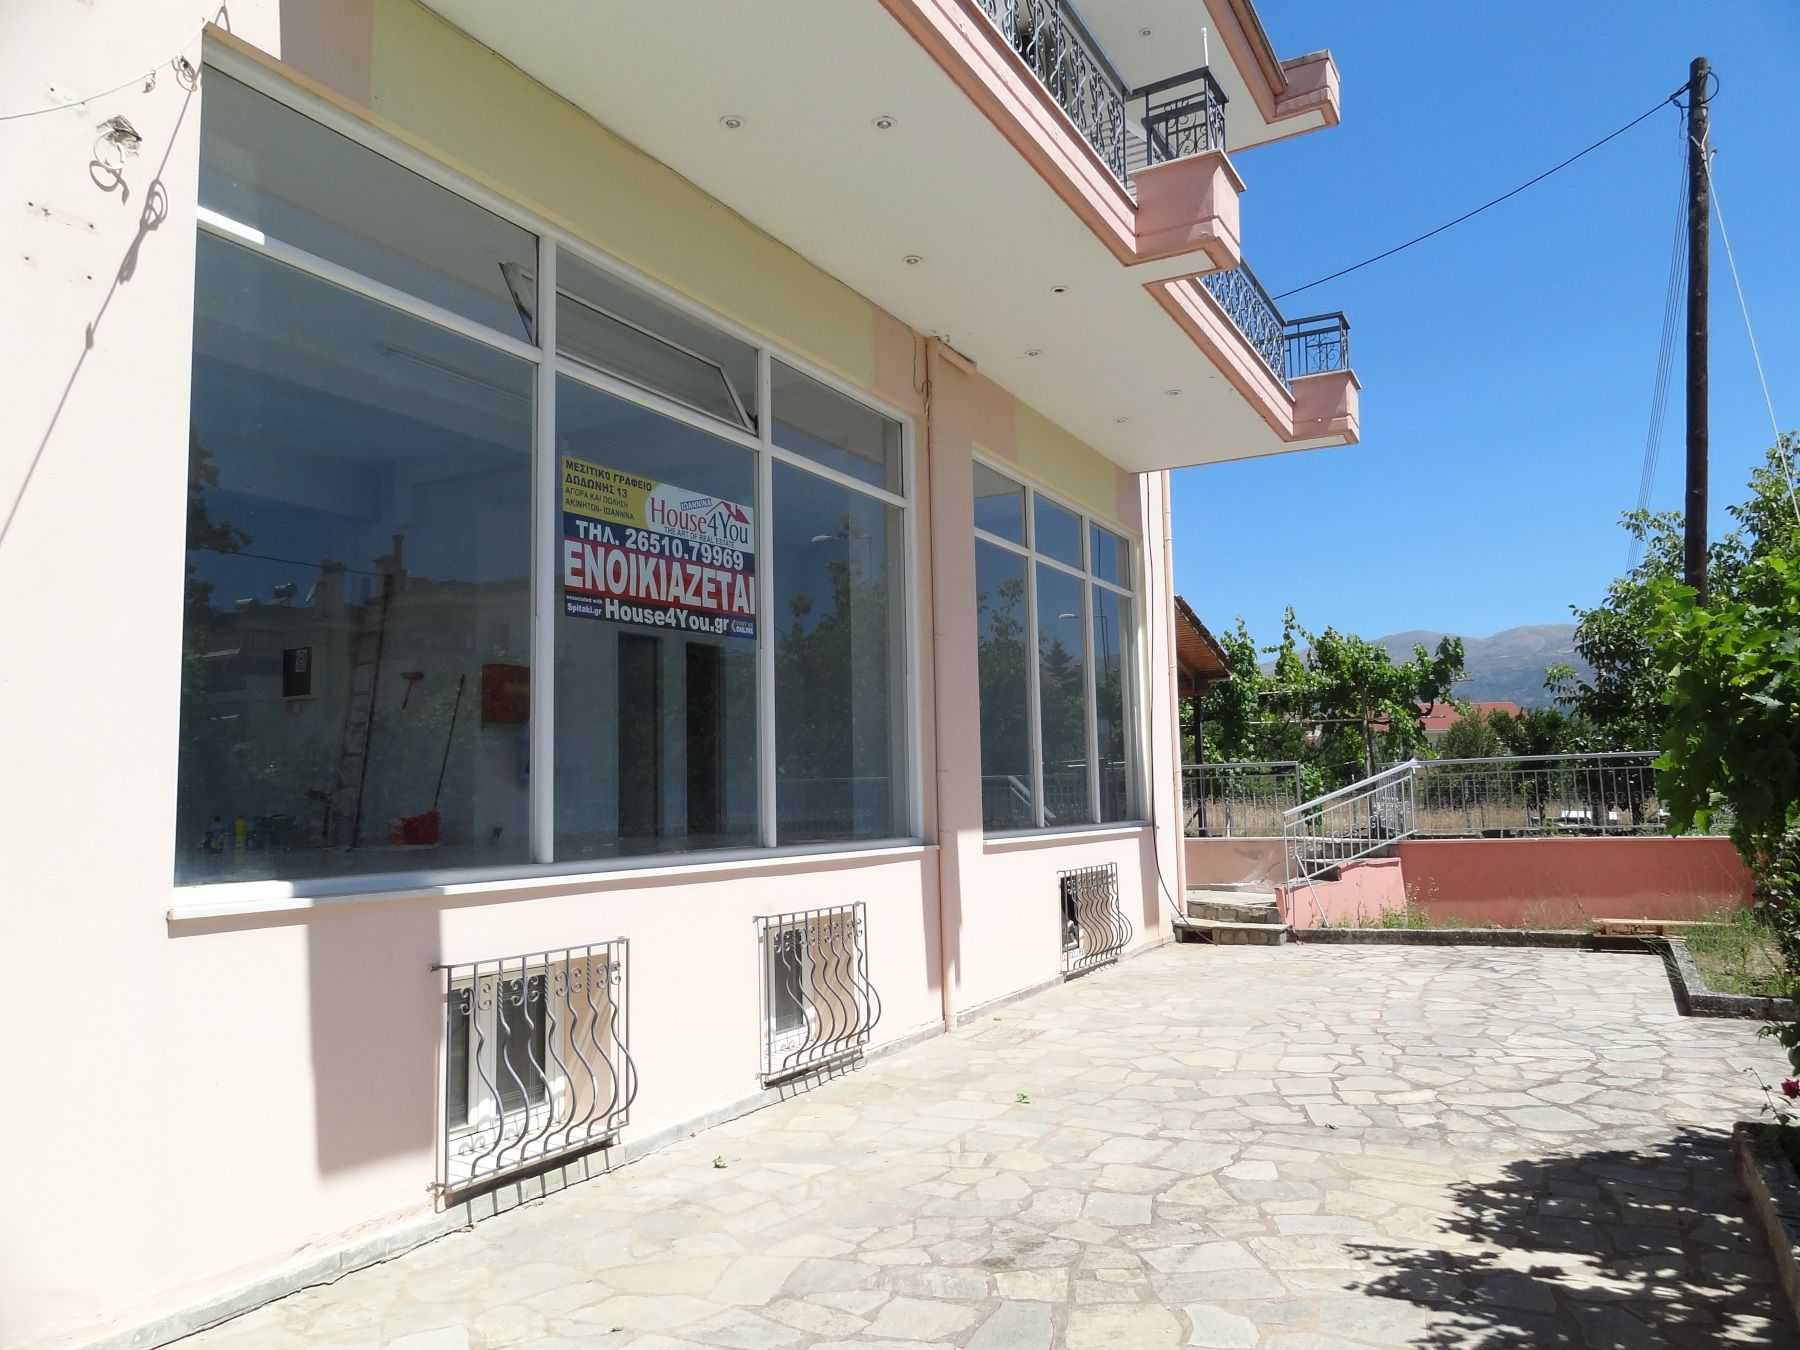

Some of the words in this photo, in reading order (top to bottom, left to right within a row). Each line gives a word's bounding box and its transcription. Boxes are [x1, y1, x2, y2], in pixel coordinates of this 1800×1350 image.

[565, 474, 614, 494] ΔΩΔΩΝΗΣ
[617, 488, 627, 498] 13
[566, 460, 610, 480] ΜΕΣΙΤΙΚΟ
[614, 474, 652, 491] ΓΡΑΦΕΙΟ
[565, 487, 588, 498] ΑΓΟΡΑ
[590, 493, 601, 501] ΚΑΙ
[576, 520, 619, 545] ΤΗΛ.
[625, 528, 743, 570] 26510.79969
[664, 526, 676, 535] THE
[677, 529, 689, 537] ART
[700, 534, 714, 542] REAL
[716, 538, 735, 548] ESTATE
[565, 540, 755, 614] ΕΝΟΙΚΙΑΖΕΤΑΙ
[567, 603, 602, 616] Spitaki.gr
[605, 598, 729, 633] House4You.gr
[736, 626, 753, 634] ONLINE
